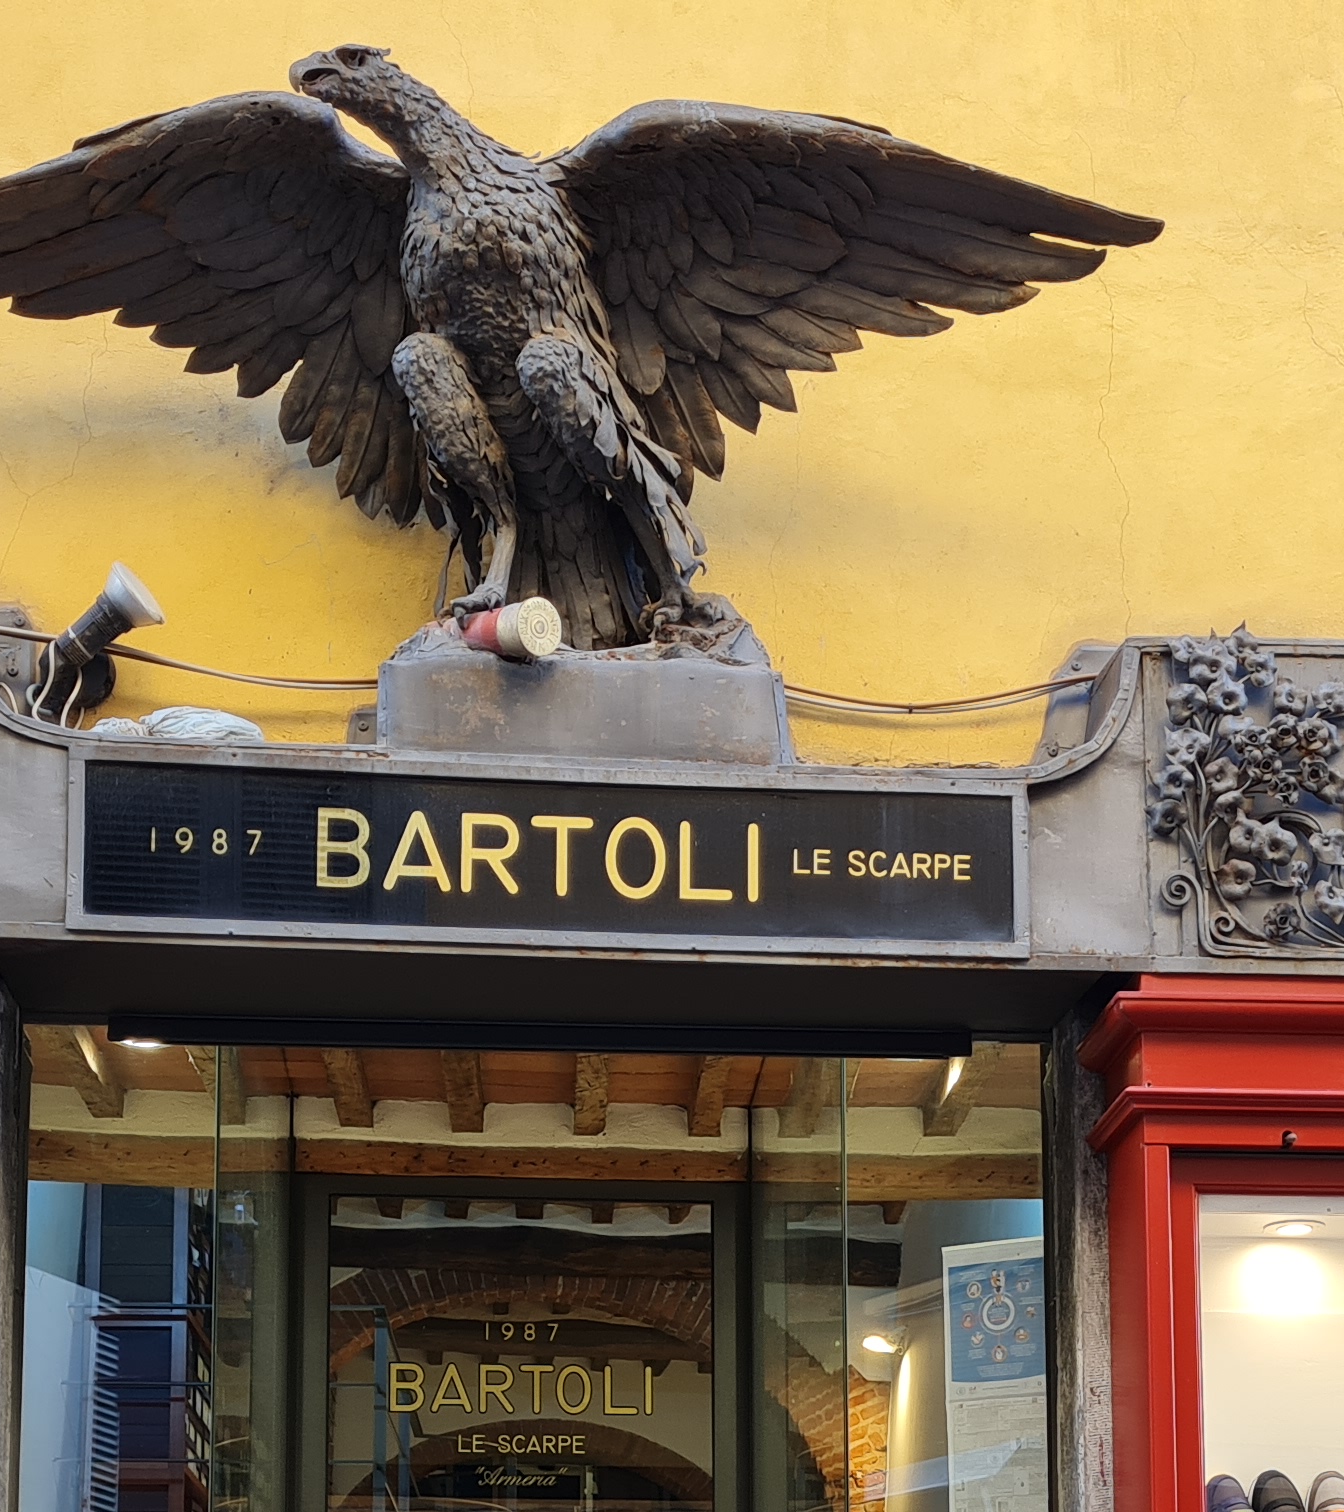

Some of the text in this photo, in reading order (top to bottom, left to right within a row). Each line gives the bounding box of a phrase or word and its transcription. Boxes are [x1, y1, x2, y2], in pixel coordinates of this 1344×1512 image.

[149, 807, 972, 903] 1987 BARTOLI LE SCARPE
[485, 1322, 559, 1342] 1987
[388, 1362, 654, 1416] BARTOLI
[457, 1434, 586, 1455] LE SCARPE
